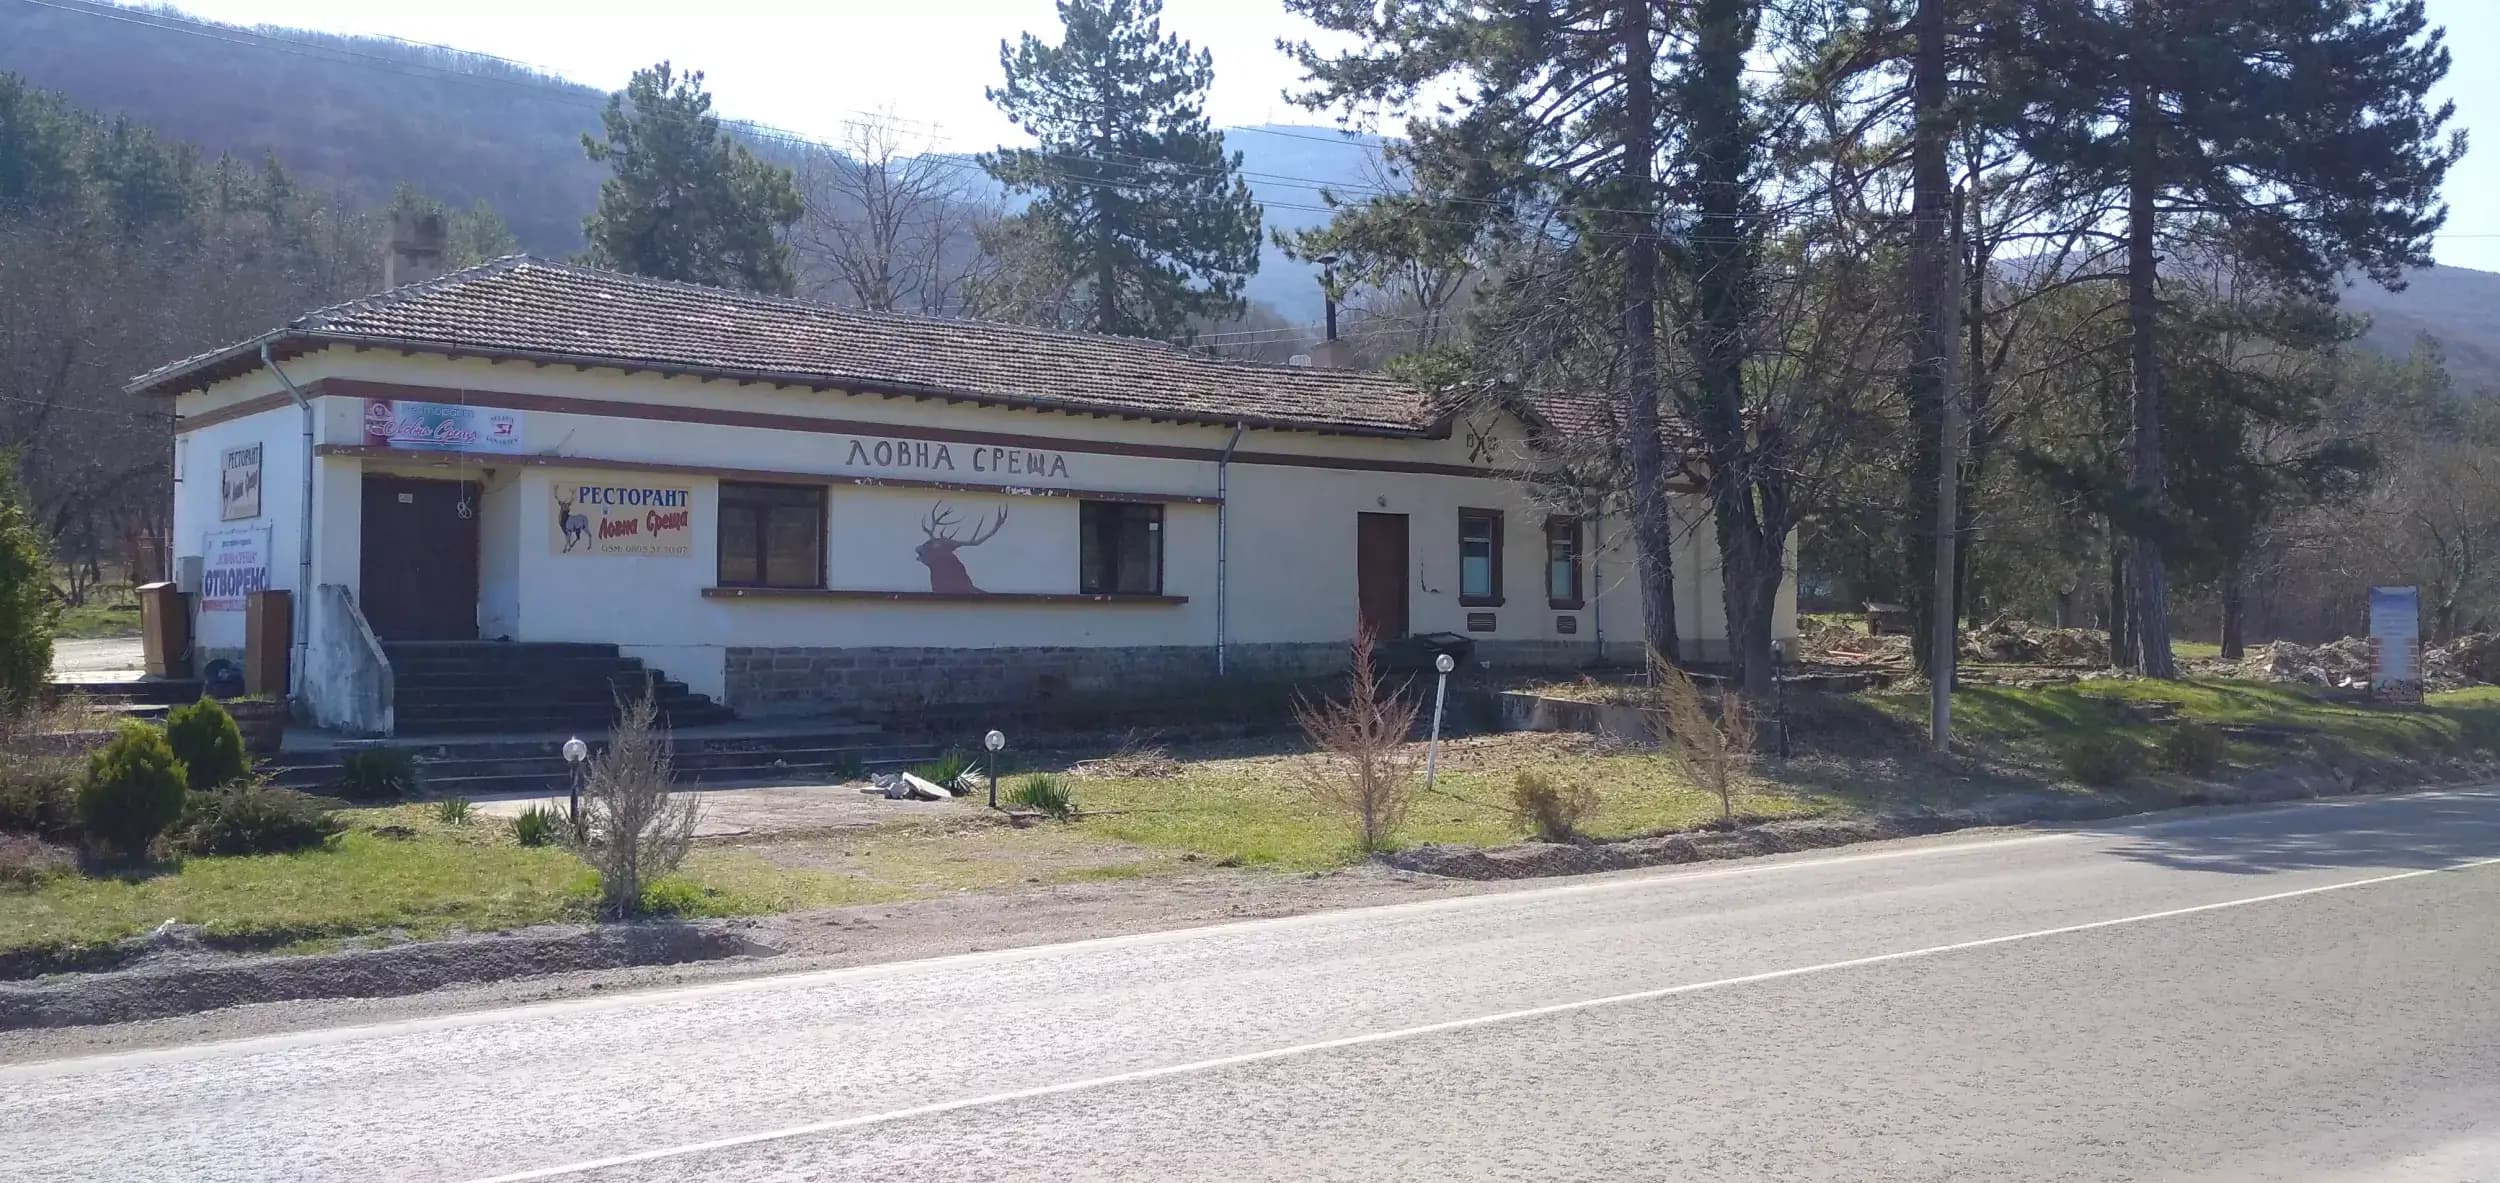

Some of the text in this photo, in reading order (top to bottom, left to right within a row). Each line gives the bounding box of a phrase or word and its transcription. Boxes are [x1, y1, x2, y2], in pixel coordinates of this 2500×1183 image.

[228, 446, 259, 470] РЕСТОРАНТ
[845, 439, 1070, 479] ЛОВНА СРЕЩА
[579, 486, 689, 507] РЕСТОРАНТ
[598, 509, 689, 540] Ловна Среща
